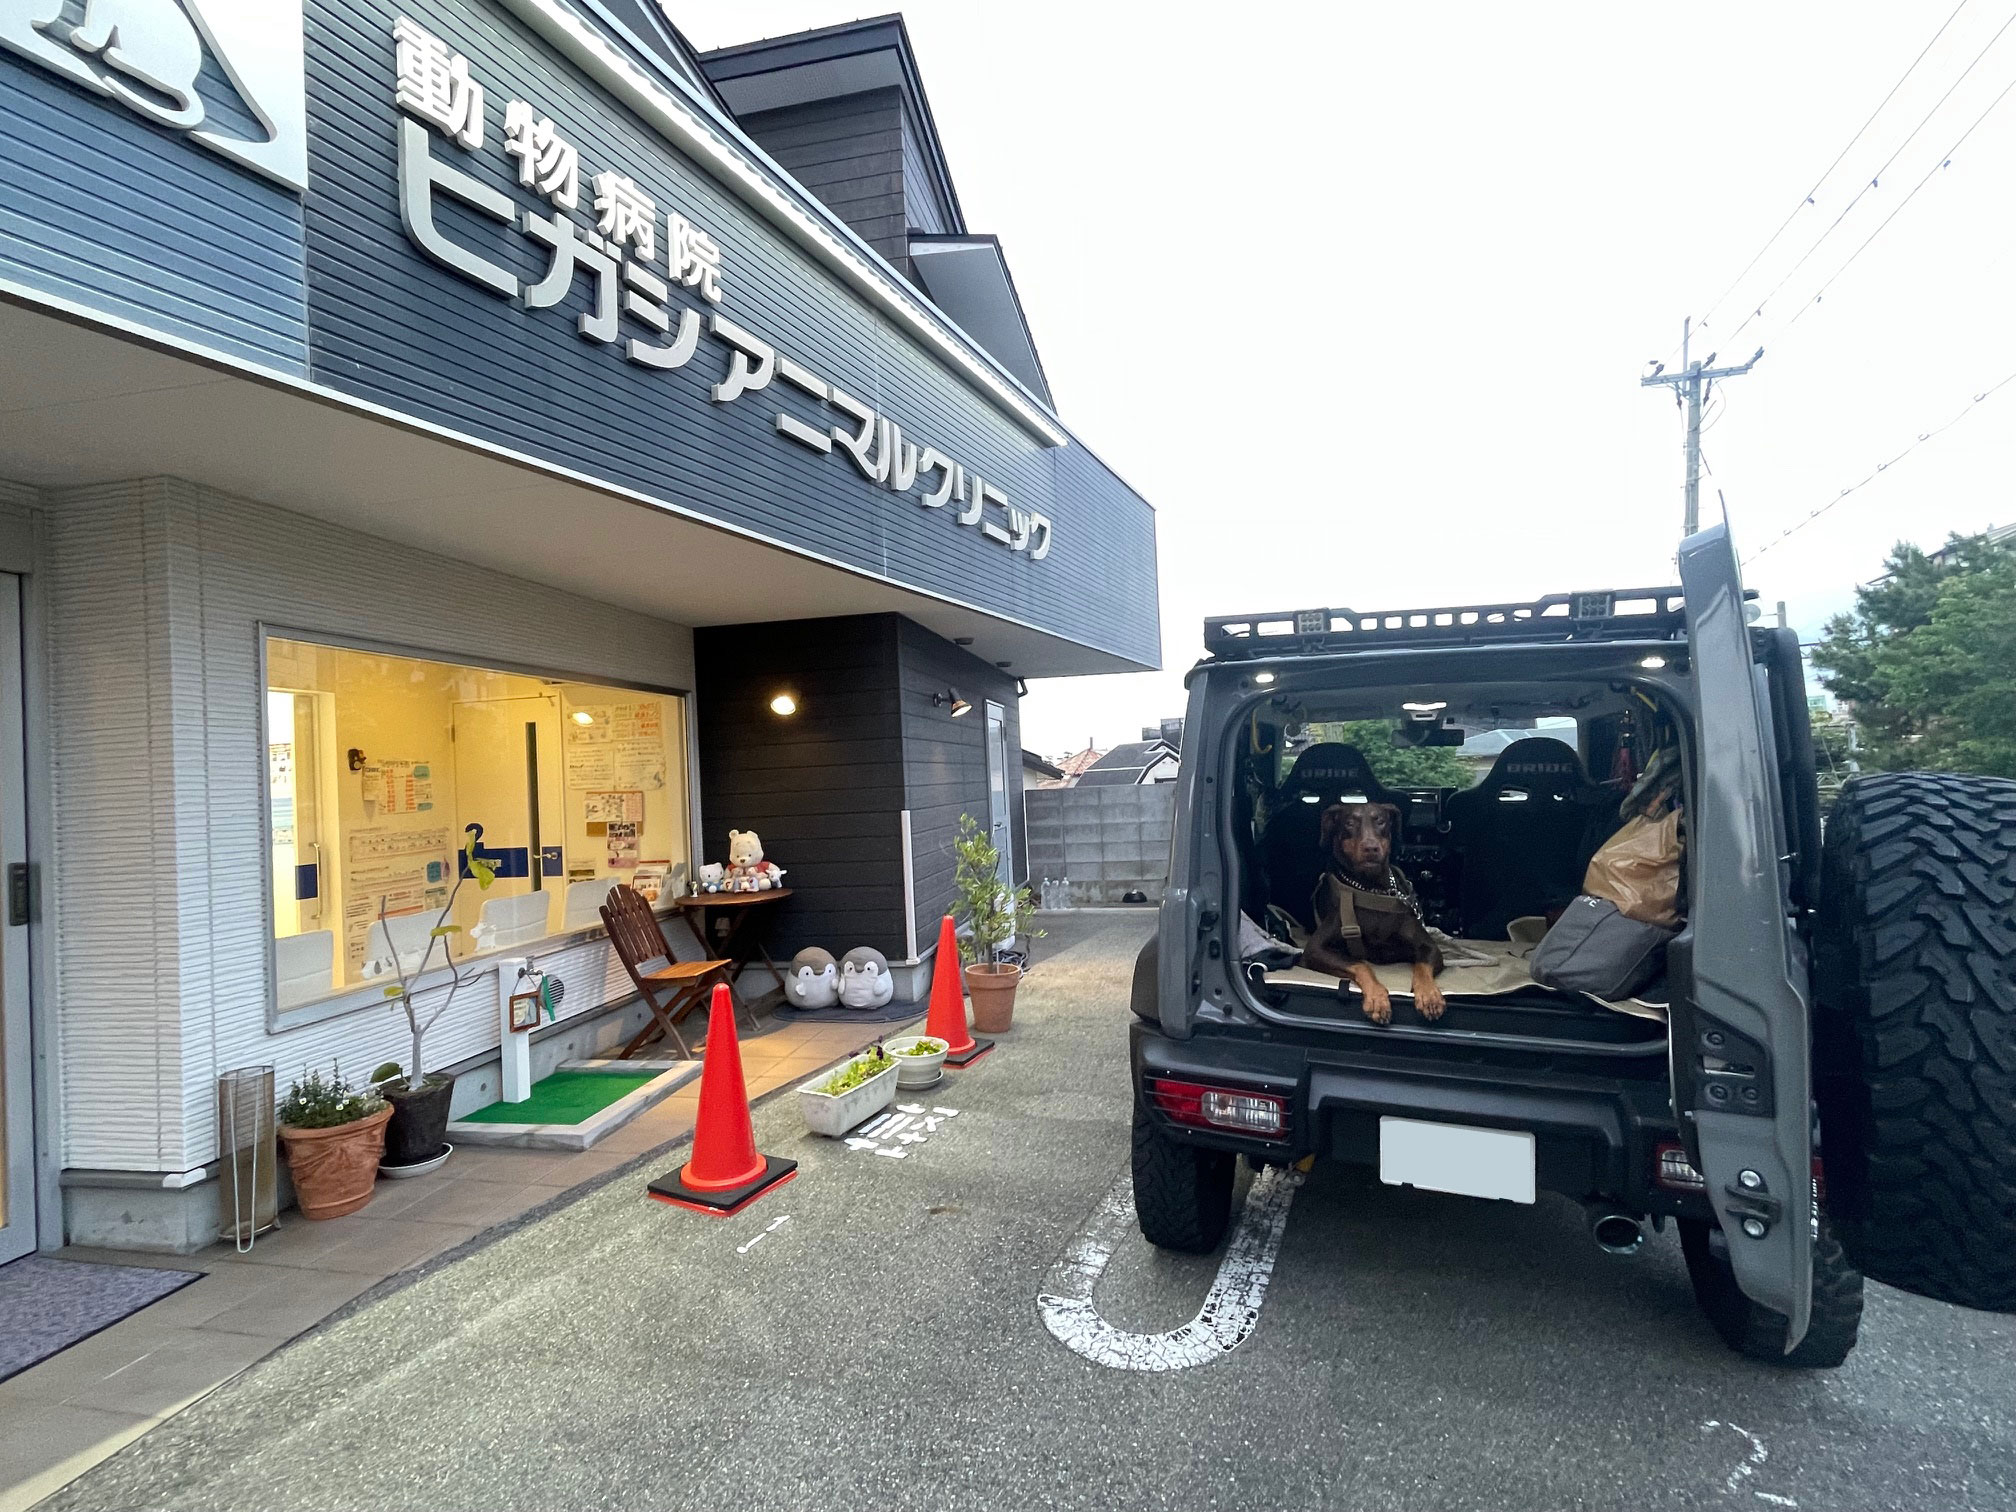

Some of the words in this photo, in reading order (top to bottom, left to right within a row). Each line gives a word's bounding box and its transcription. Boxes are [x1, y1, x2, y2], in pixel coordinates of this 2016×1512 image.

[393, 15, 722, 304] 動物病院
[398, 116, 1052, 561] ヒガシアニマルクリニック
[1506, 762, 1574, 774] BRIDE
